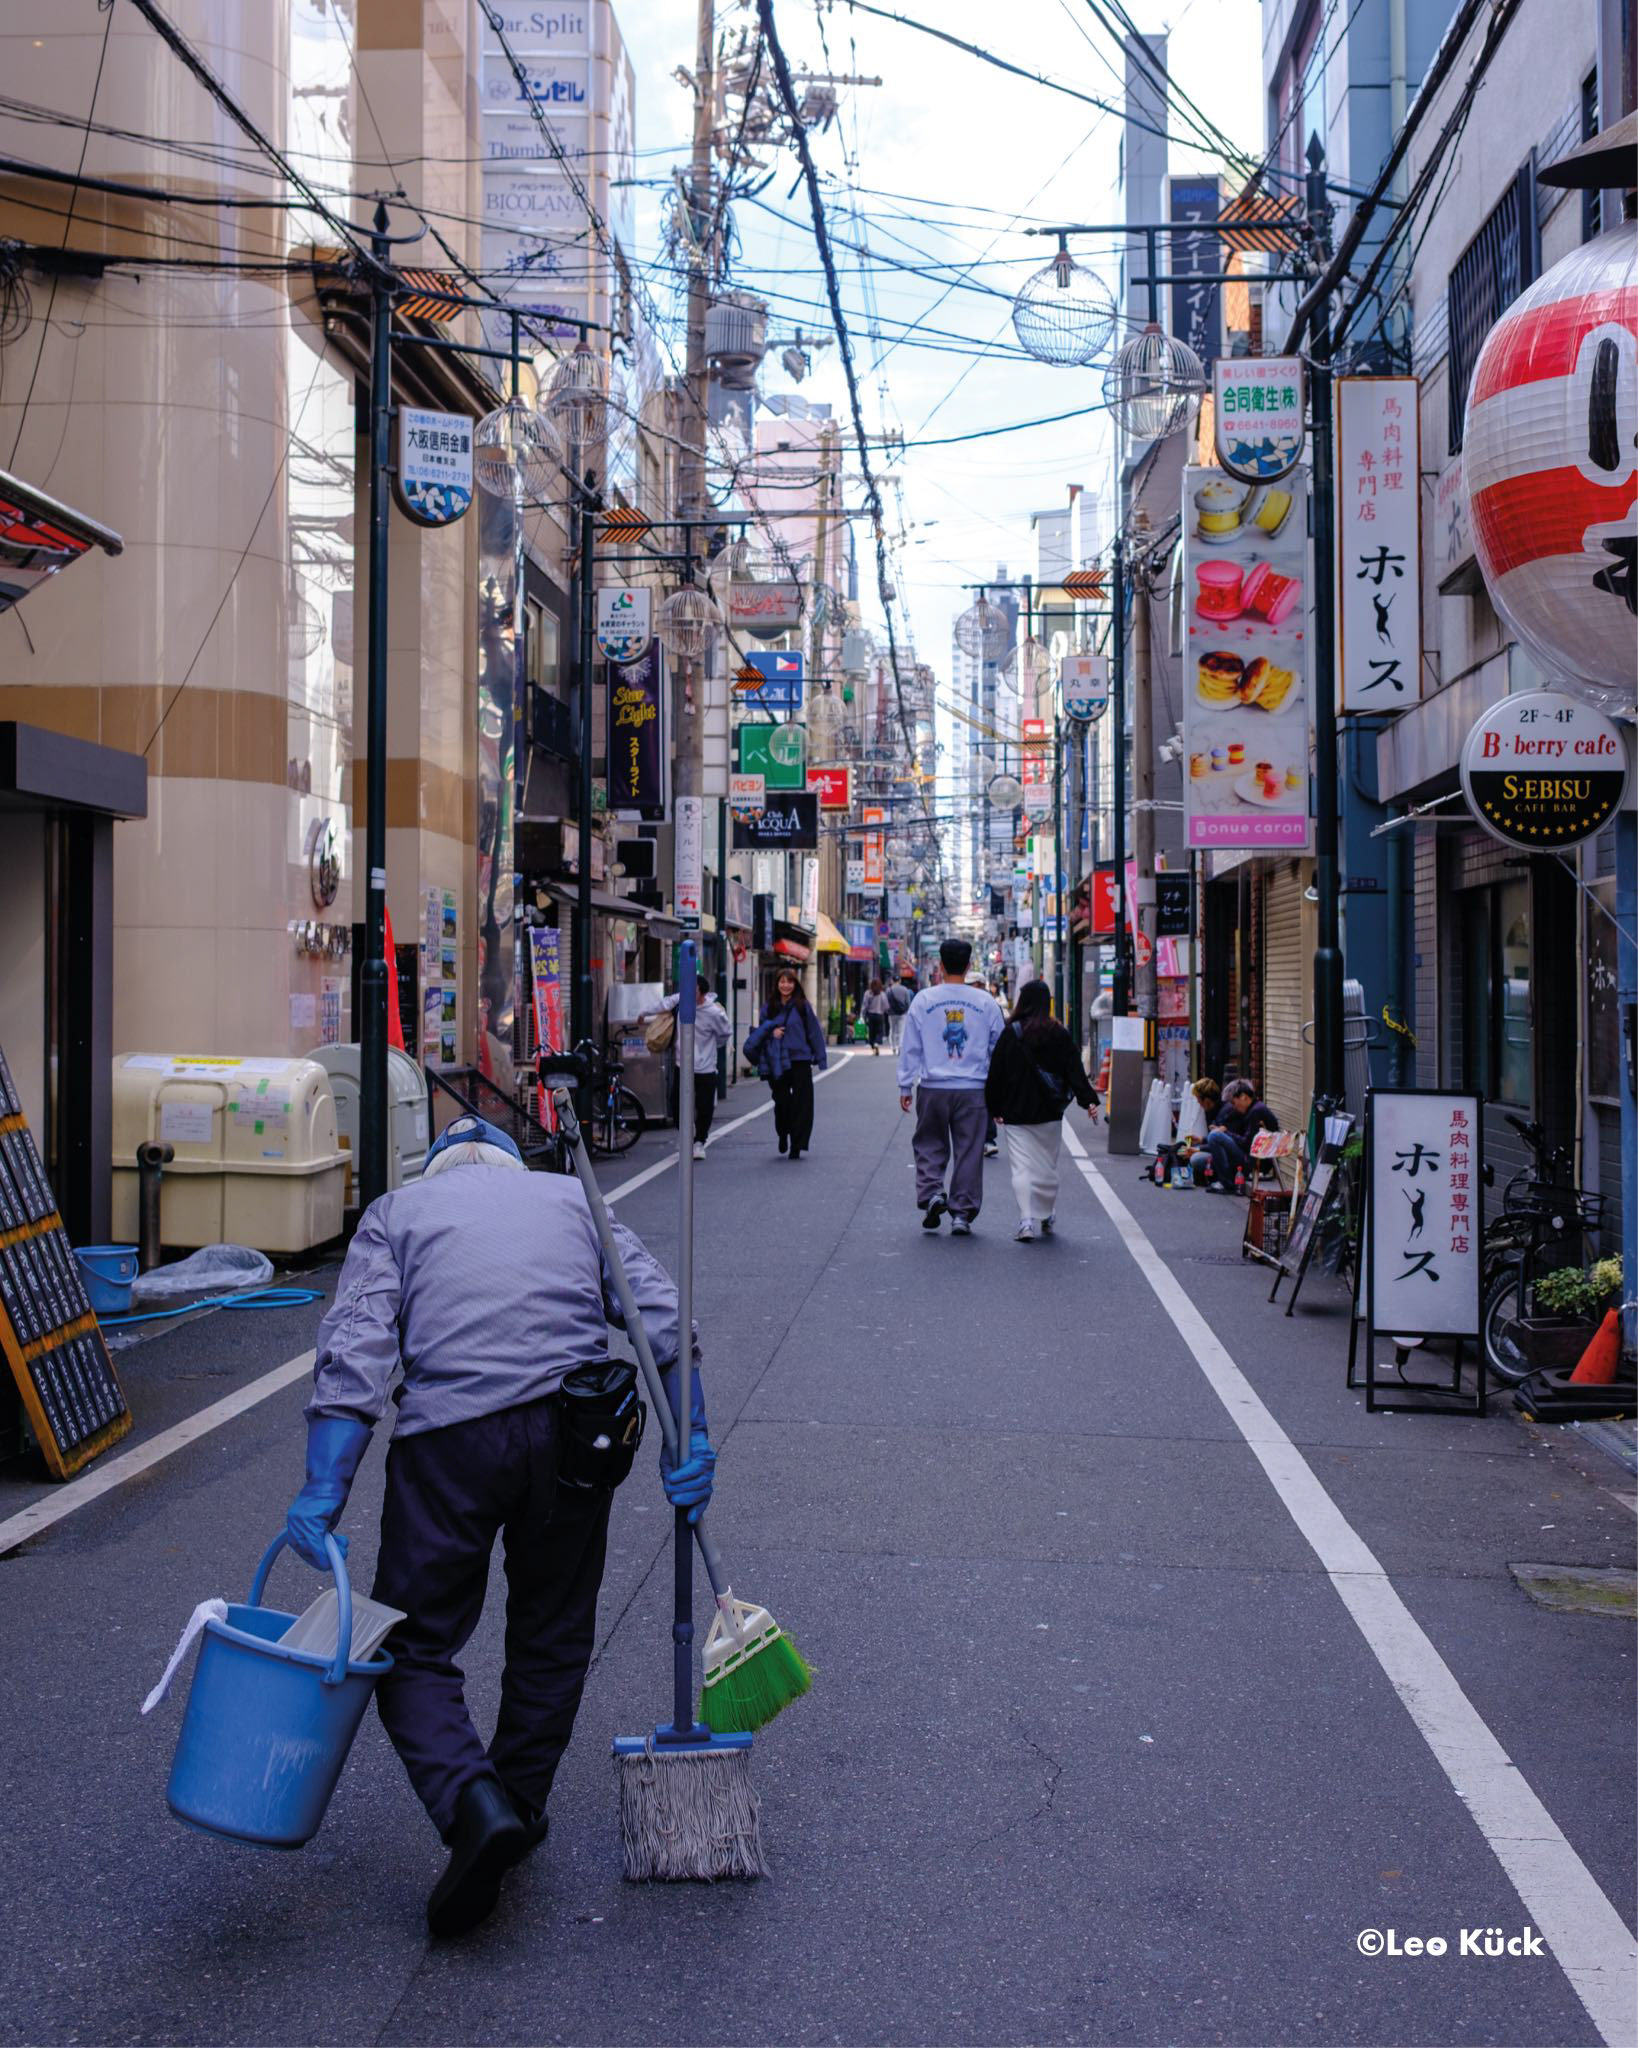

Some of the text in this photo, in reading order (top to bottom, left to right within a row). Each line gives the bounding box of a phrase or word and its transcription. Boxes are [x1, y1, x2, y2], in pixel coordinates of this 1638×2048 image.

[408, 427, 470, 455] 大阪信用金庫
[1383, 398, 1403, 490] 馬肉料理
[616, 702, 657, 728] Light
[1574, 734, 1616, 755] cafe
[630, 736, 640, 797] スターライト
[1514, 803, 1576, 813] CAFE BAR
[1254, 822, 1302, 834] caron
[1450, 1110, 1470, 1254] 馬肉料理専門店
